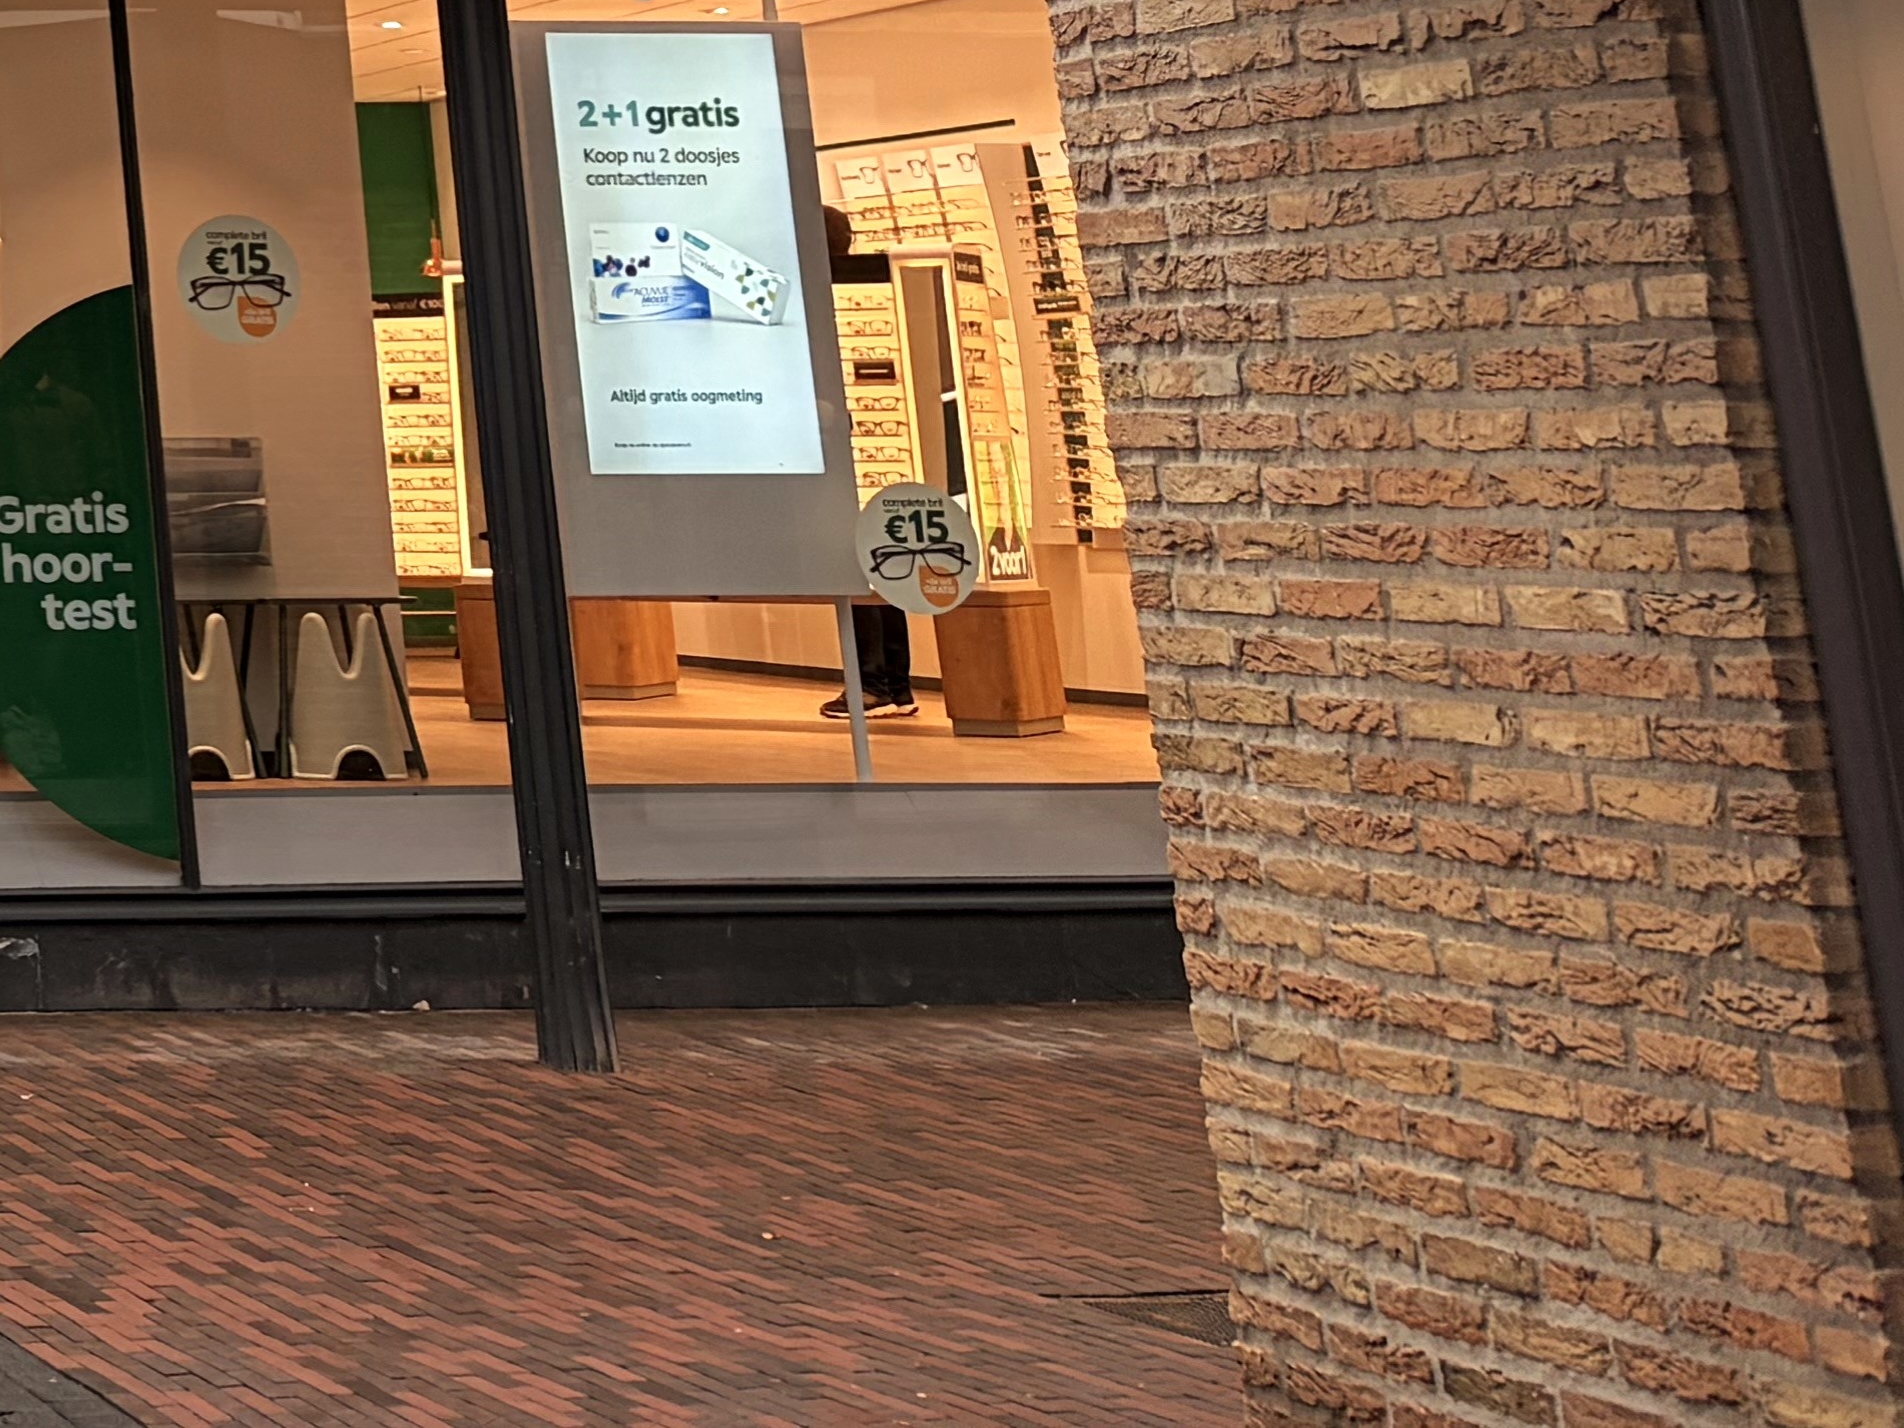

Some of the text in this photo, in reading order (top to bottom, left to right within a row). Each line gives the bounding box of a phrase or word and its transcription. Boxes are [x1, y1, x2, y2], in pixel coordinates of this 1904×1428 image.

[645, 97, 740, 135] gratis
[583, 147, 741, 168] Koop nu 2 doosjes
[585, 171, 708, 187] contactlenzen
[206, 242, 271, 276] €15
[610, 388, 763, 405] Altijd gratis oogmeting
[884, 509, 949, 544] €15
[1, 541, 135, 585] hoor-
[41, 591, 138, 633] test
